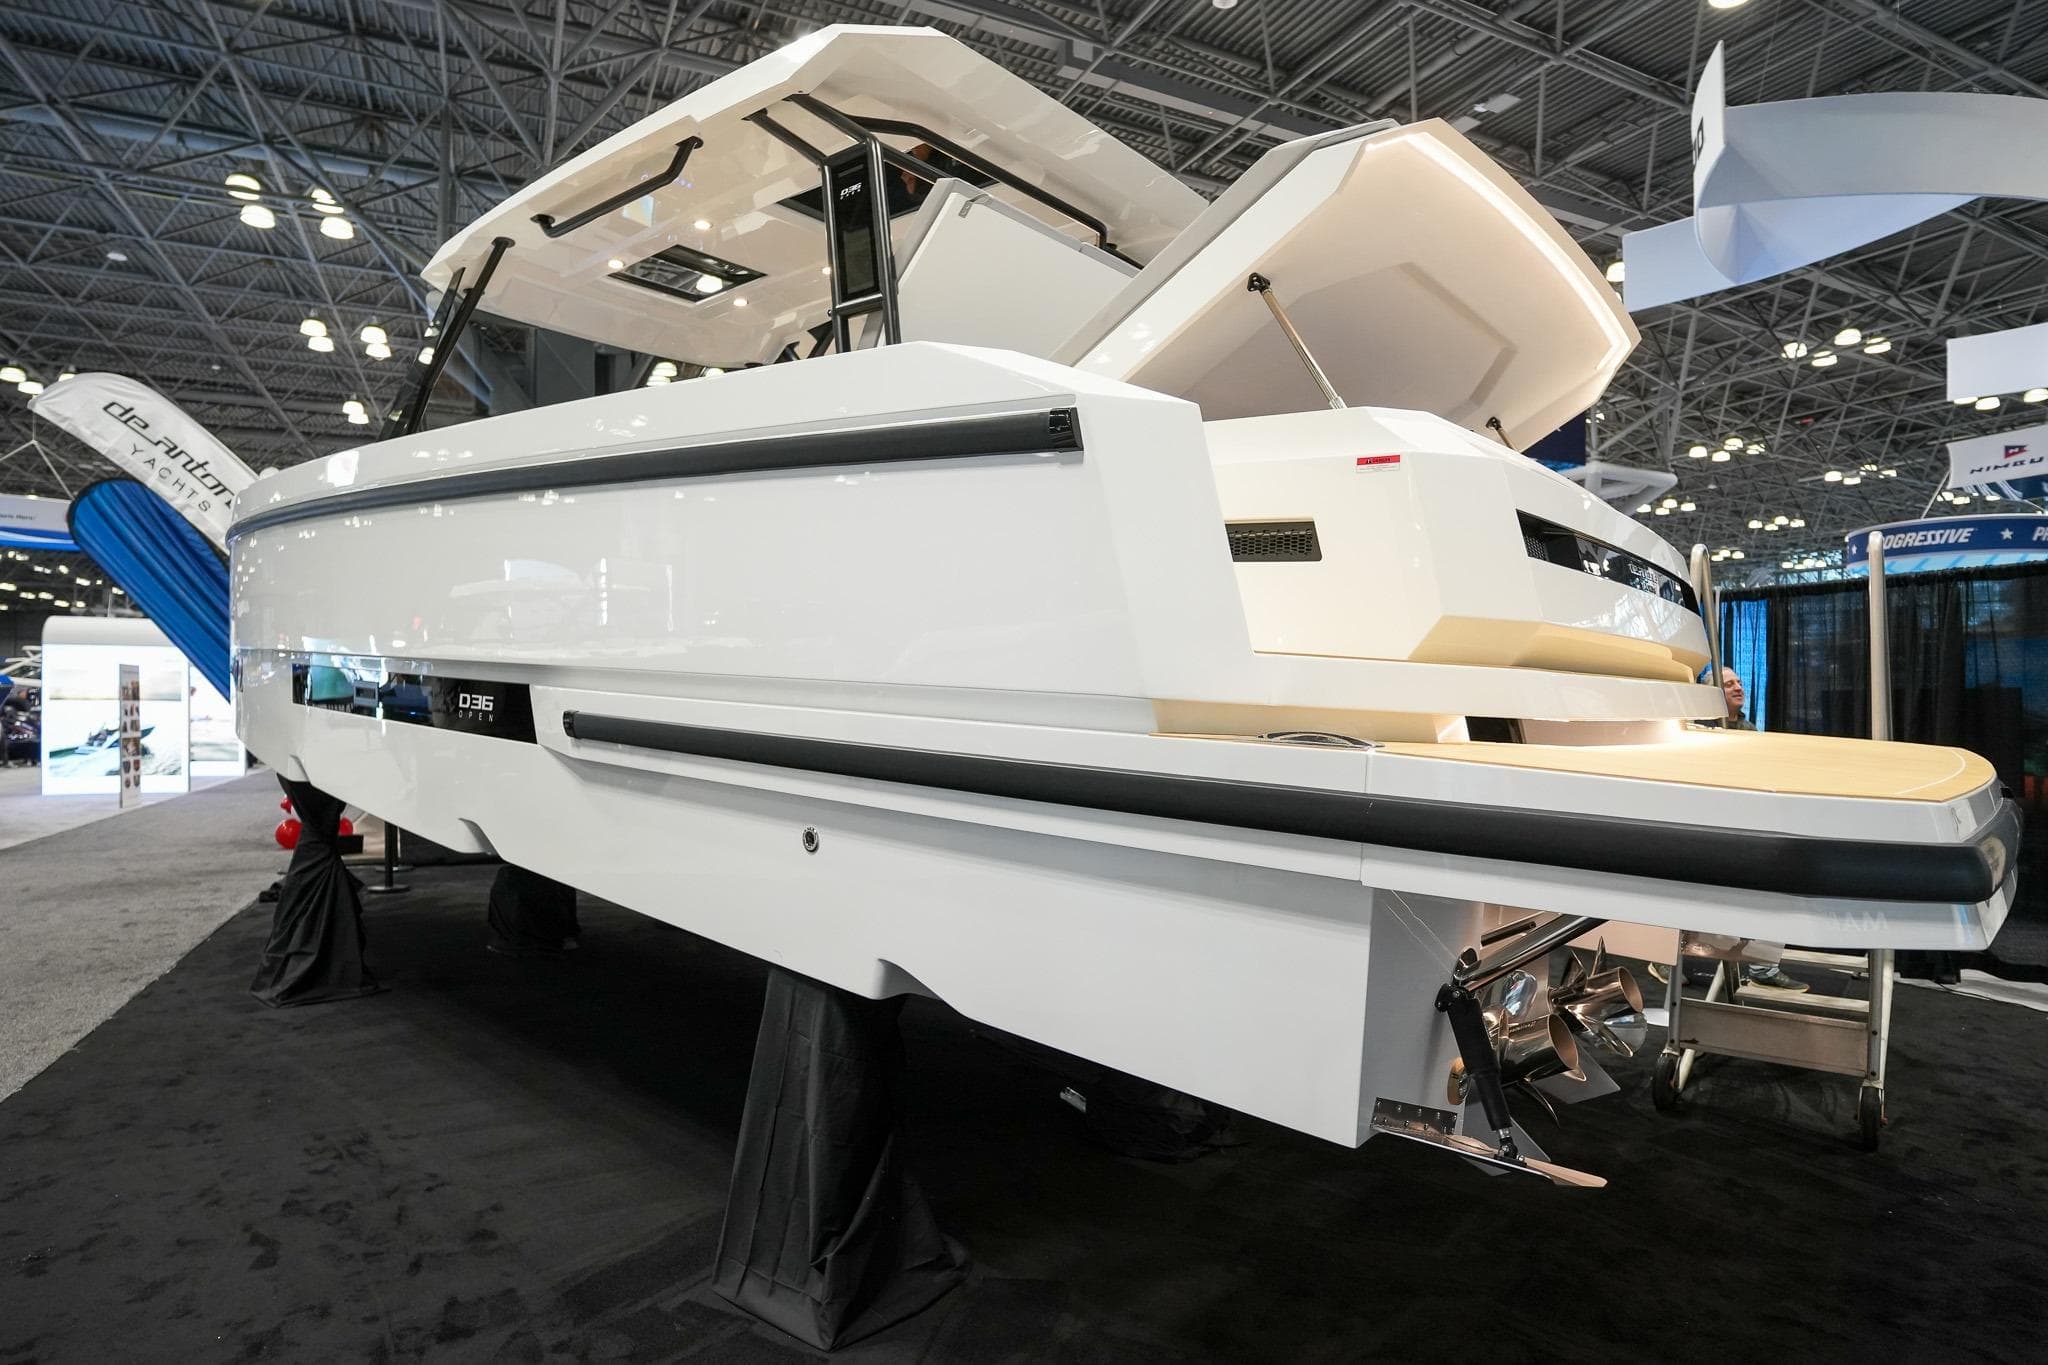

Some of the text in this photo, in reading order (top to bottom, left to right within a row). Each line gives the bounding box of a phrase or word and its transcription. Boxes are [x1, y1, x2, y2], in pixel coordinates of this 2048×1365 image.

[1970, 456, 2044, 474] NIMBU
[131, 443, 211, 512] YACHTS
[1866, 528, 1974, 550] OGRESSIVE
[459, 693, 494, 711] D36
[458, 710, 494, 723] OPEN
